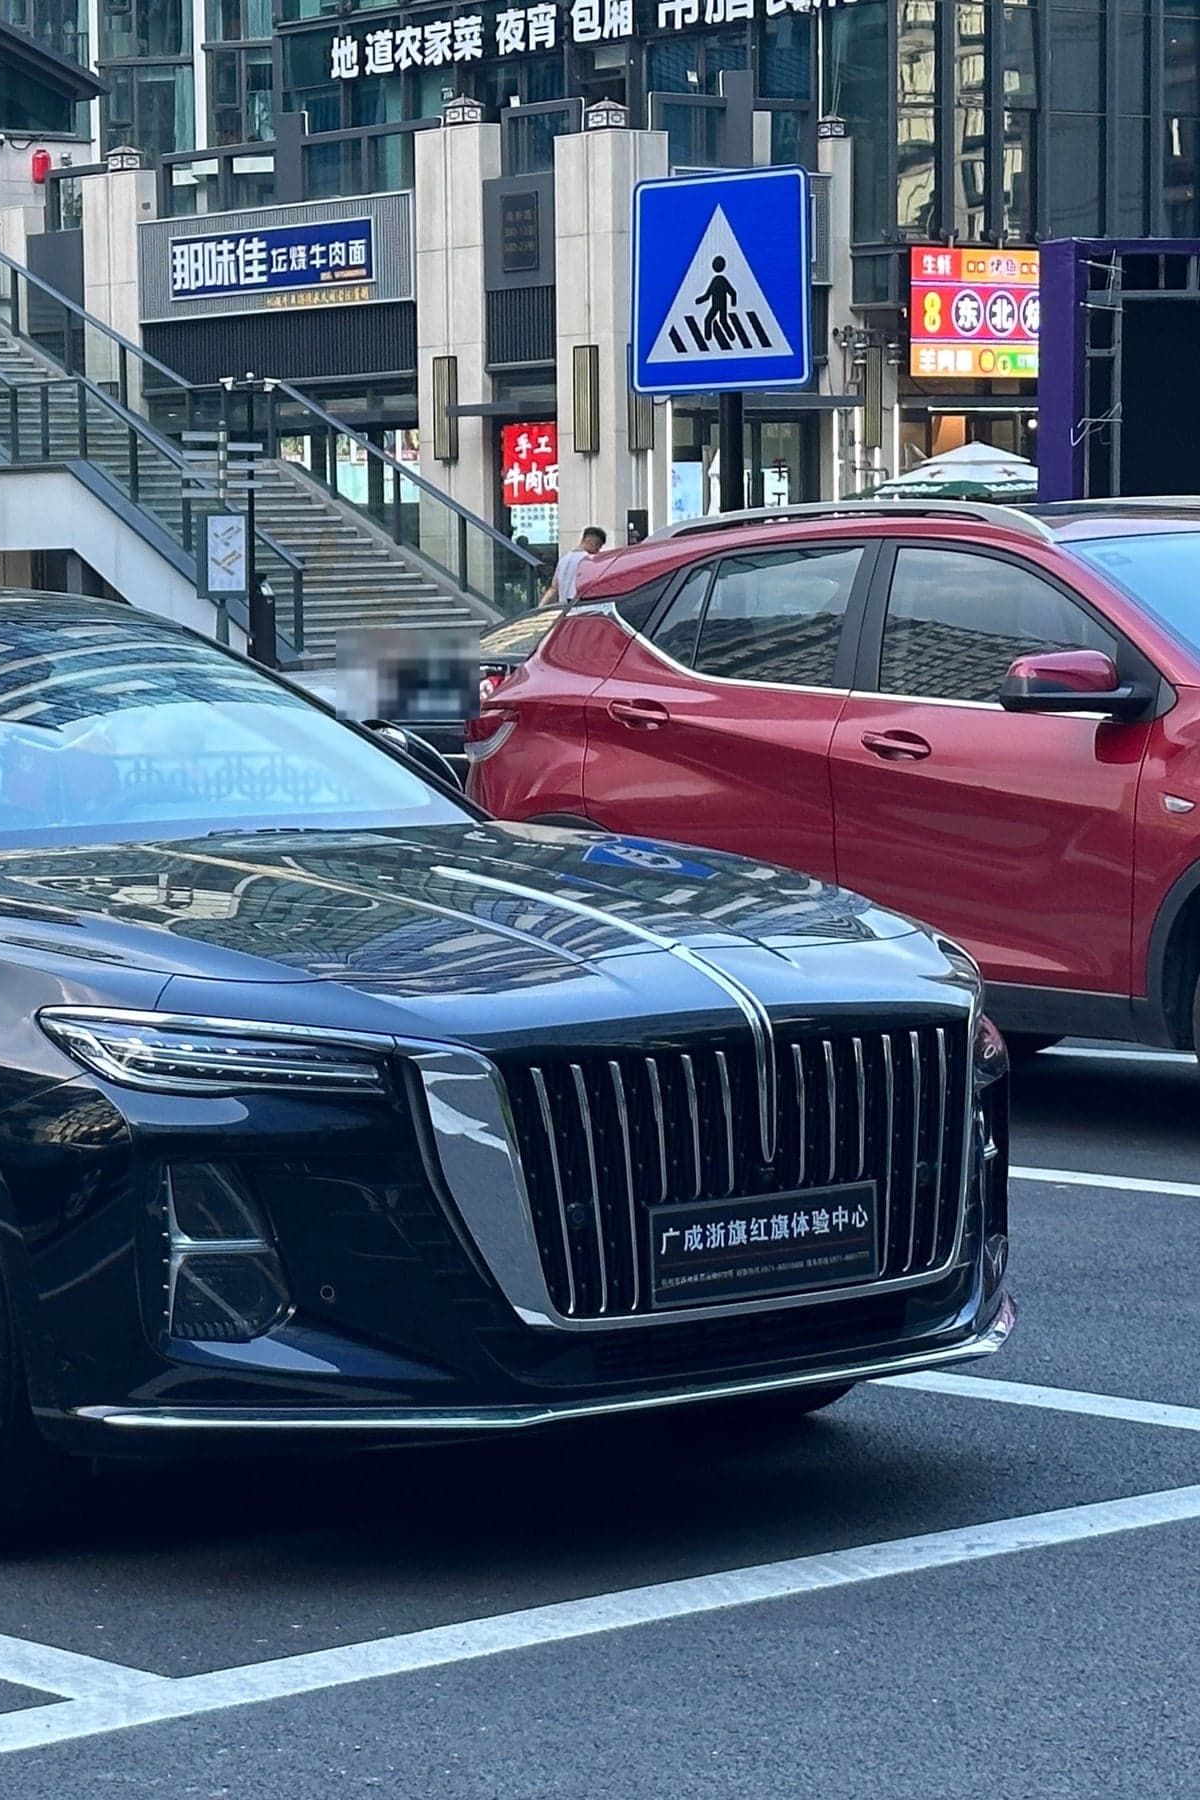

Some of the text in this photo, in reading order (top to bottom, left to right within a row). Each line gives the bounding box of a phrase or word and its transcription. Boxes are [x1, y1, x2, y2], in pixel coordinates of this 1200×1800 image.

[330, 14, 483, 79] 地道农家菜
[495, 3, 557, 55] 夜宵
[570, 0, 633, 43] 包厢
[172, 237, 367, 290] 那味佳 坛烧牛肉面
[514, 432, 552, 459] 手工
[504, 461, 559, 498] 牛肉面
[660, 1204, 869, 1255] 广成浙旗红旗体验中心
